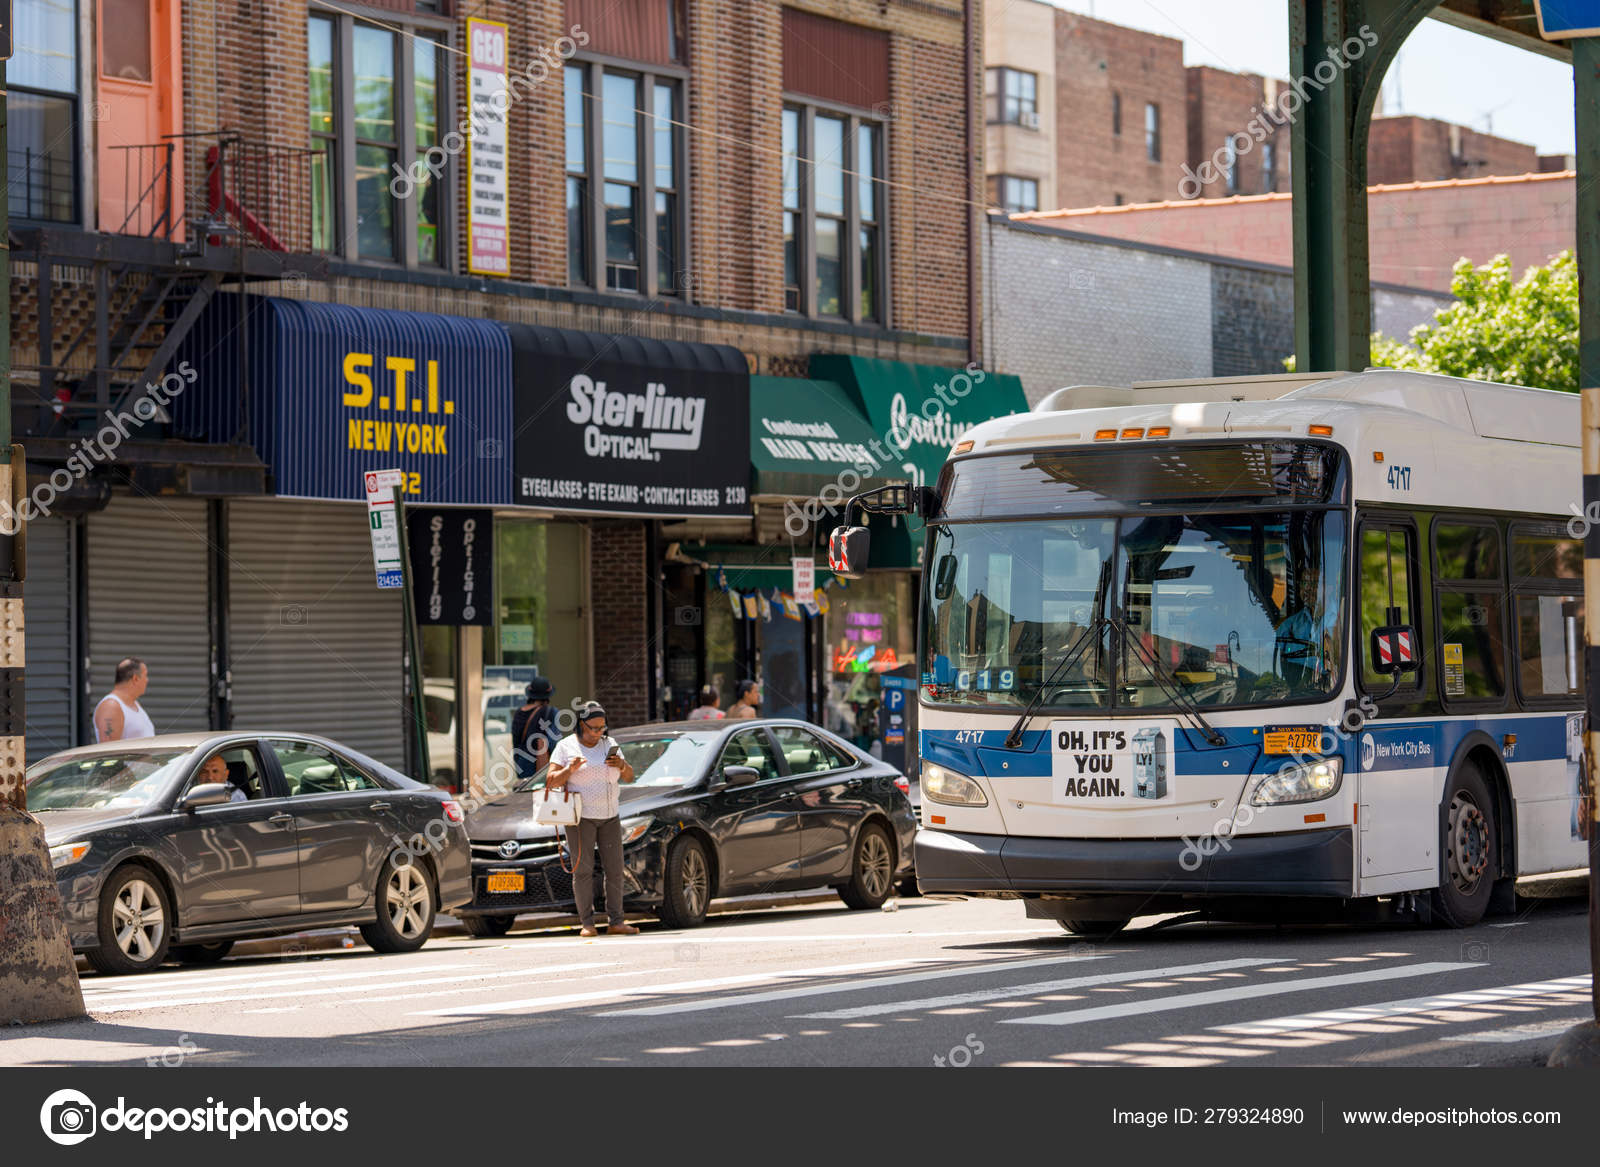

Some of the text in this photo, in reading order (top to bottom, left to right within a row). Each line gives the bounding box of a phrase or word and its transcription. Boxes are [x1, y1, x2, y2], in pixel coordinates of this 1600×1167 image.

[473, 28, 504, 67] GEO
[343, 352, 455, 415] S.T.I.
[566, 373, 706, 451] Sterling
[348, 418, 448, 455] NEW YORK
[761, 417, 839, 440] Continental
[760, 437, 814, 461] HAIR
[1387, 465, 1411, 491] 4717
[521, 477, 746, 507] EYEGLASSES EYE EXAMS CONTACT LENSES 2130
[430, 515, 443, 621] Sterling
[955, 730, 985, 744] 4717
[1058, 731, 1127, 752] OH, IT'S
[1376, 739, 1431, 758] New York City Bus
[1073, 754, 1113, 773] YOU
[1065, 778, 1125, 797] AGAIN.
